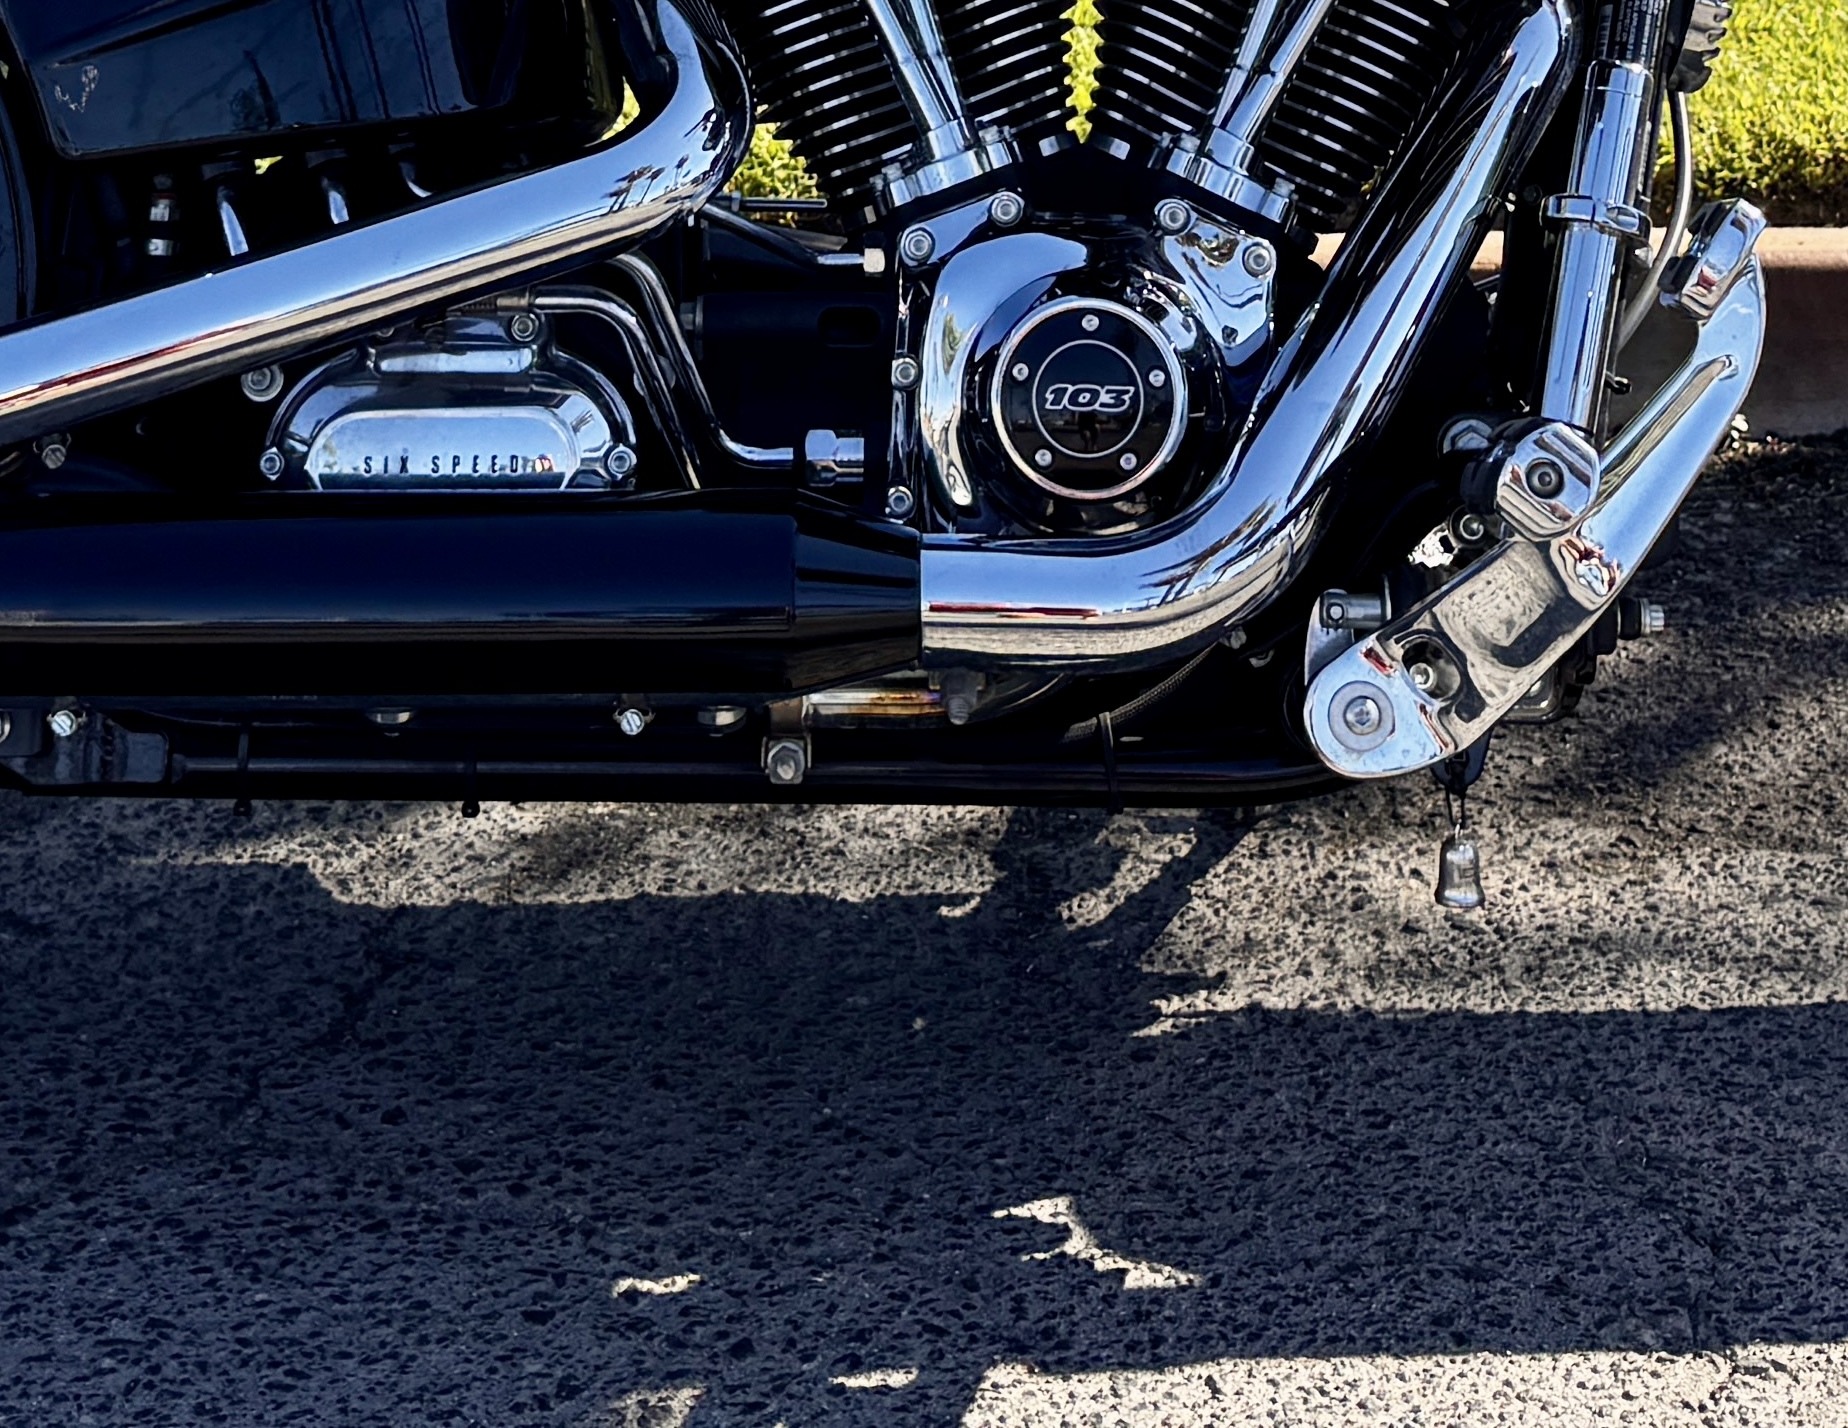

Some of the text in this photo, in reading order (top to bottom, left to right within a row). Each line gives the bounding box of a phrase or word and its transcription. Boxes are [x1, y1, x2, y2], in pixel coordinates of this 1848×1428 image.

[1044, 383, 1136, 413] 103
[363, 454, 519, 475] SIX SPEED
